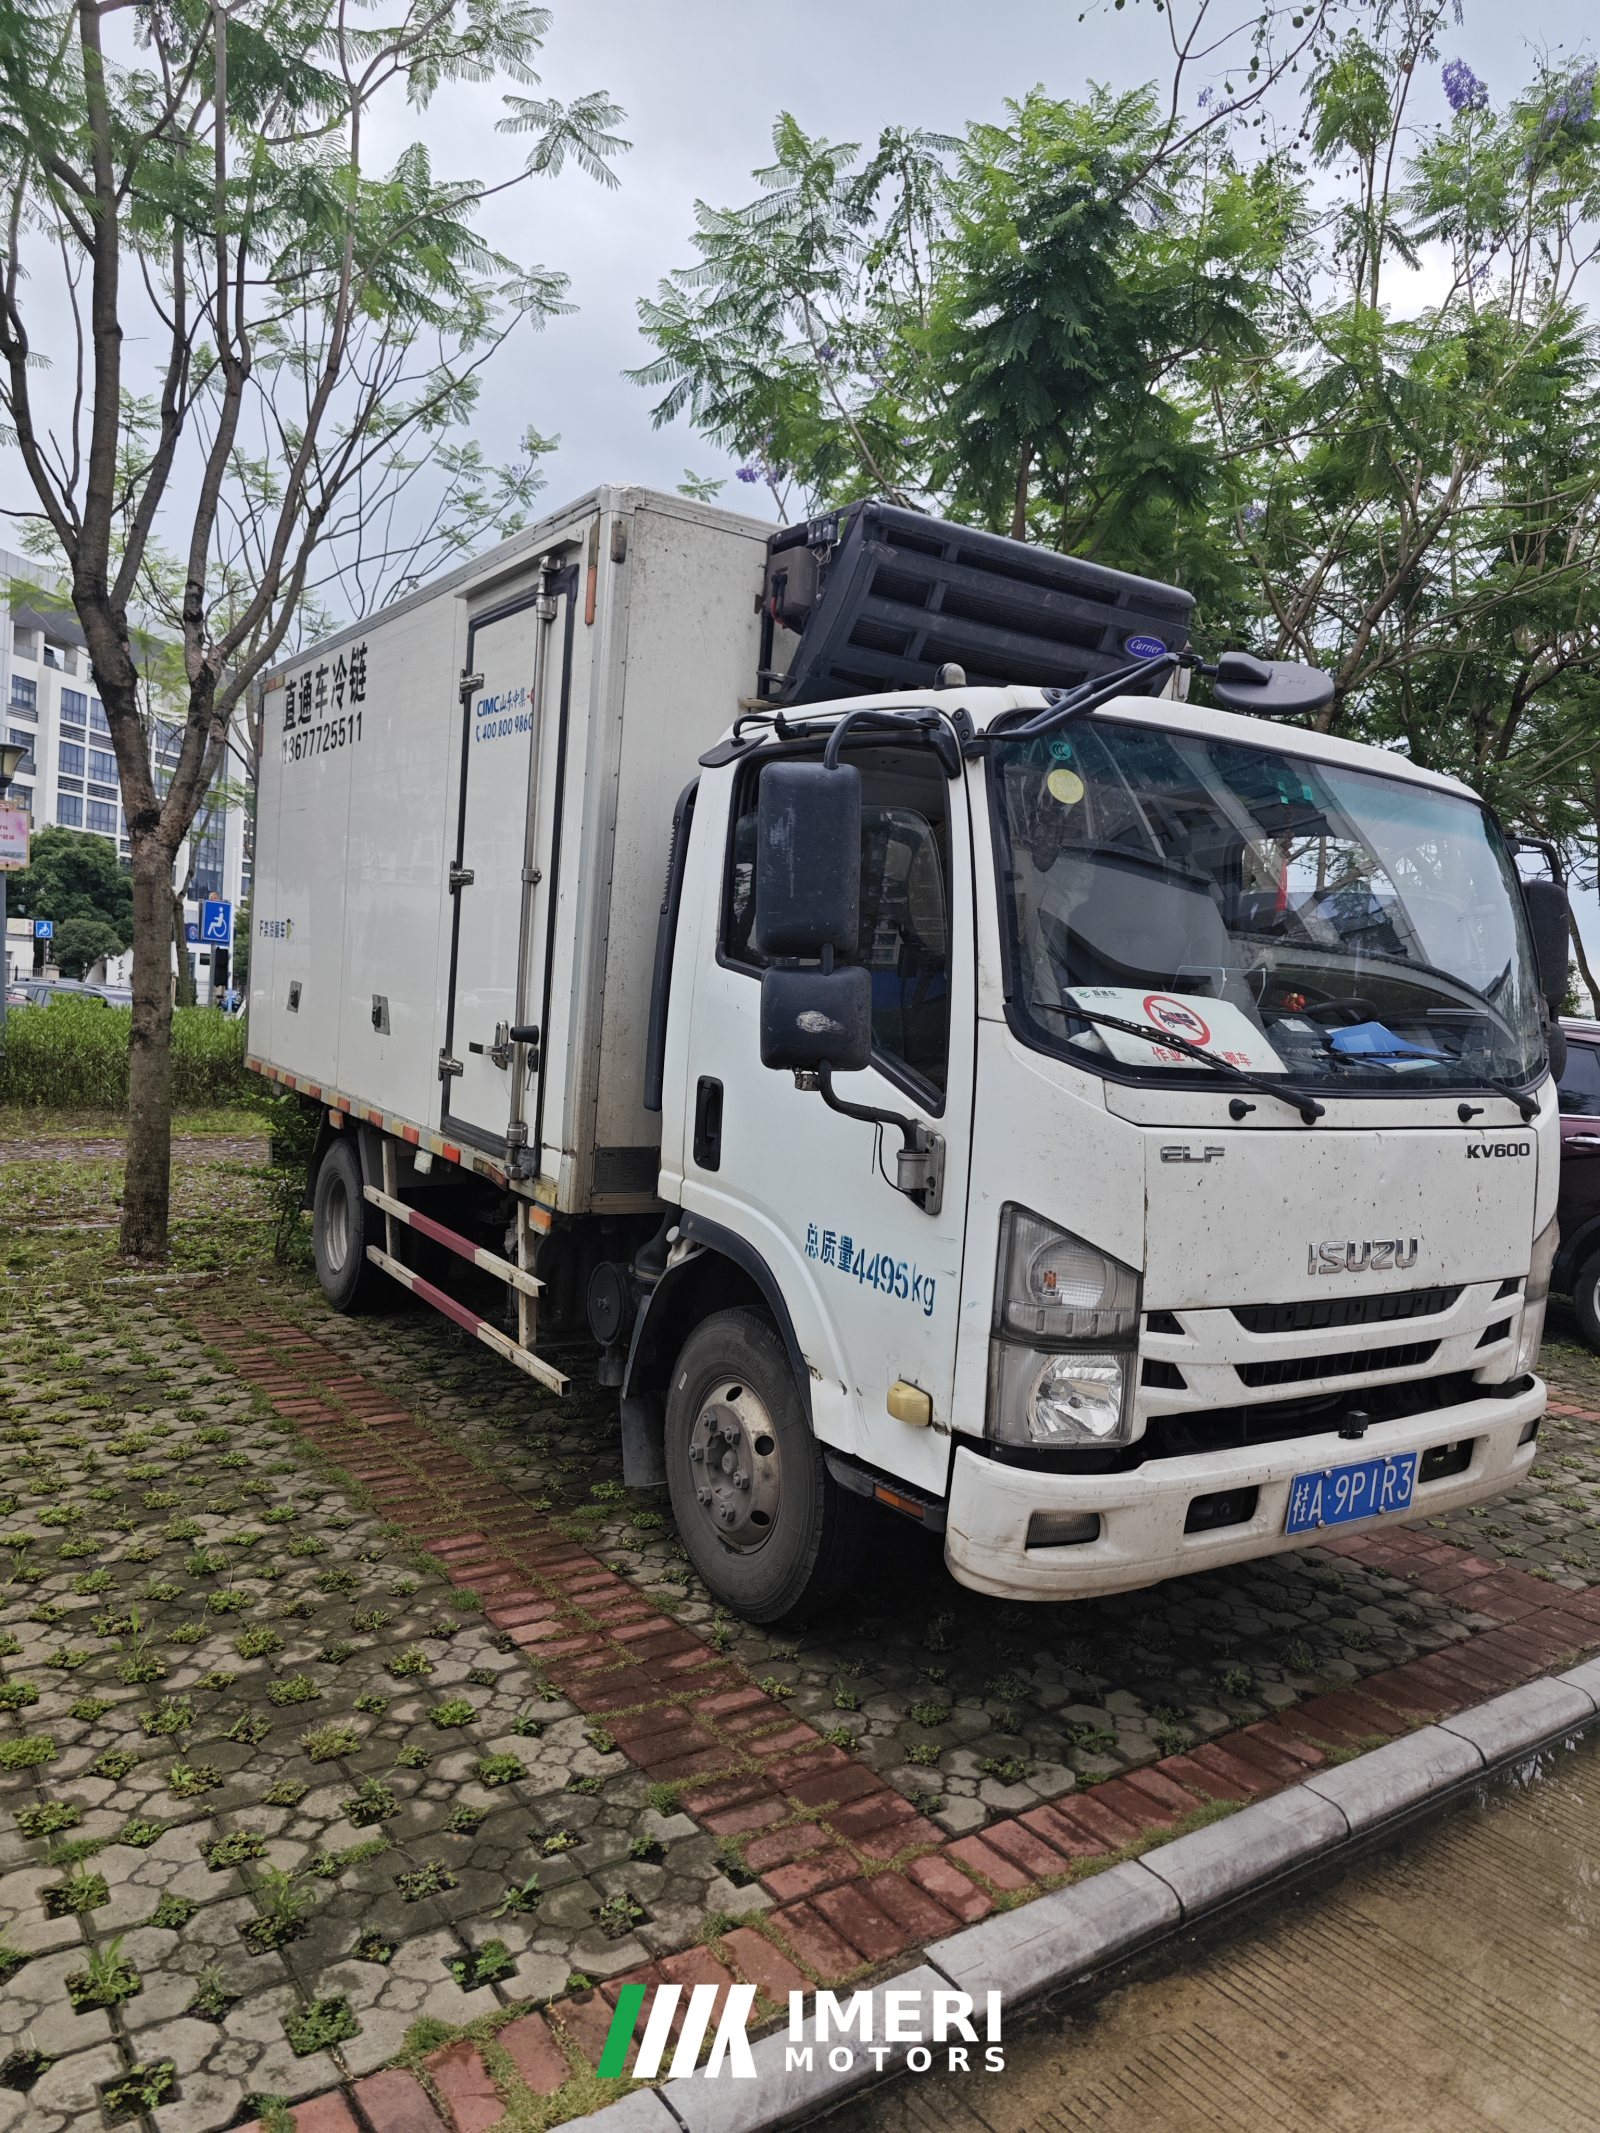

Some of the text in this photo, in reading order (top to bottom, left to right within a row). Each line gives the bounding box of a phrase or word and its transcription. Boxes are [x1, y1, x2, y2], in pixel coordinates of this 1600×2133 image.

[1131, 639, 1161, 654] Carrier
[283, 642, 368, 732] 直通车冷链
[283, 711, 362, 765] 13677725511
[1160, 1146, 1225, 1163] ELF
[1467, 1143, 1530, 1159] KV600
[1307, 1237, 1418, 1275] ISUZU
